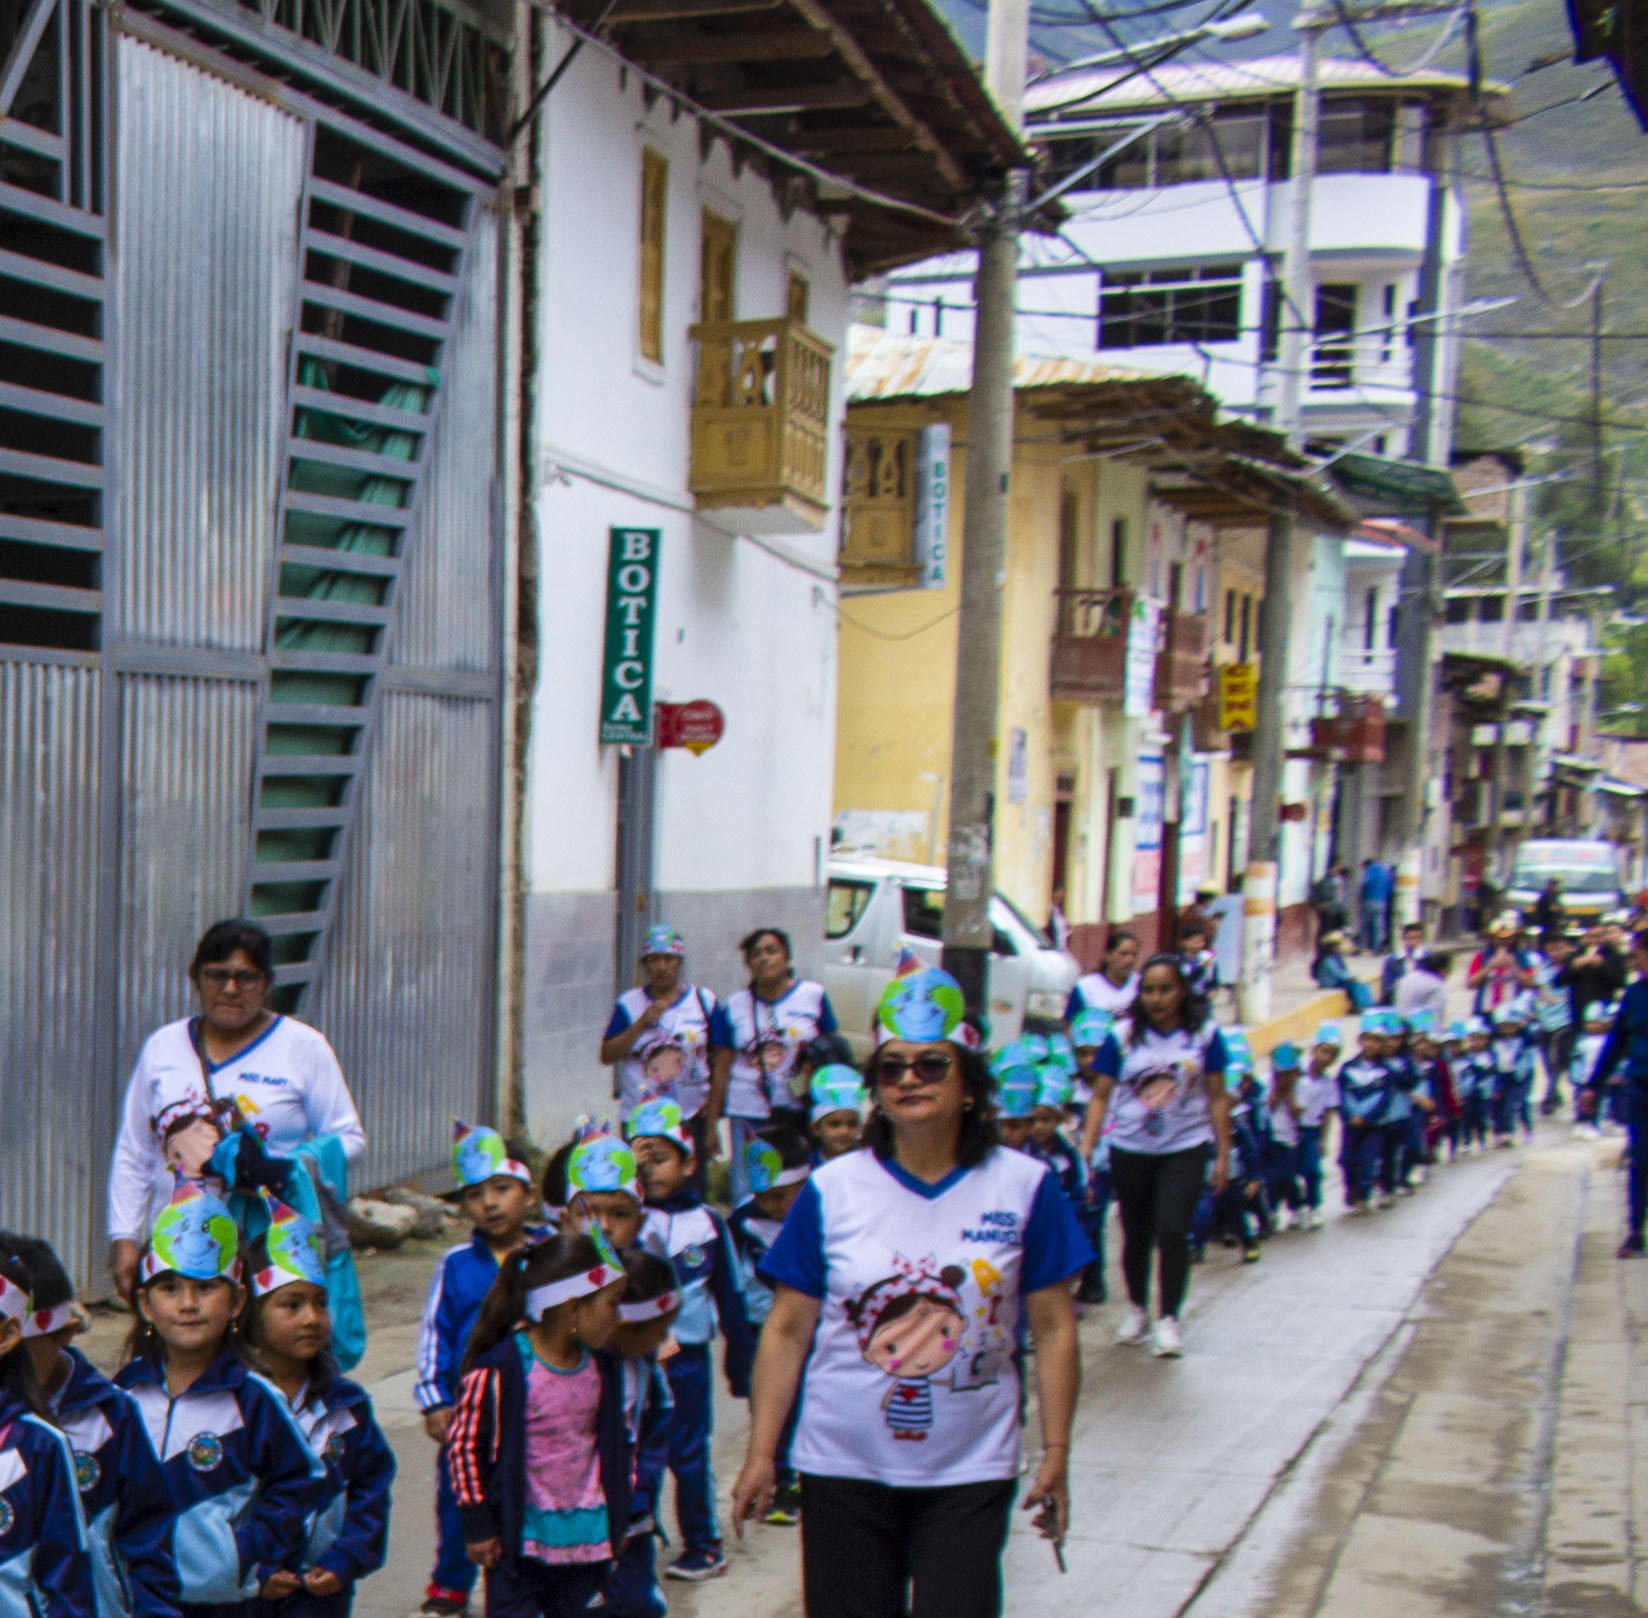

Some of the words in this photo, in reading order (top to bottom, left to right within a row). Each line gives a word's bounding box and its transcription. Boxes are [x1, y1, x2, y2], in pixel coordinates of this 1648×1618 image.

[931, 461, 946, 580] BOTICA
[612, 531, 650, 721] BOTICA
[981, 1211, 1017, 1227] MISS
